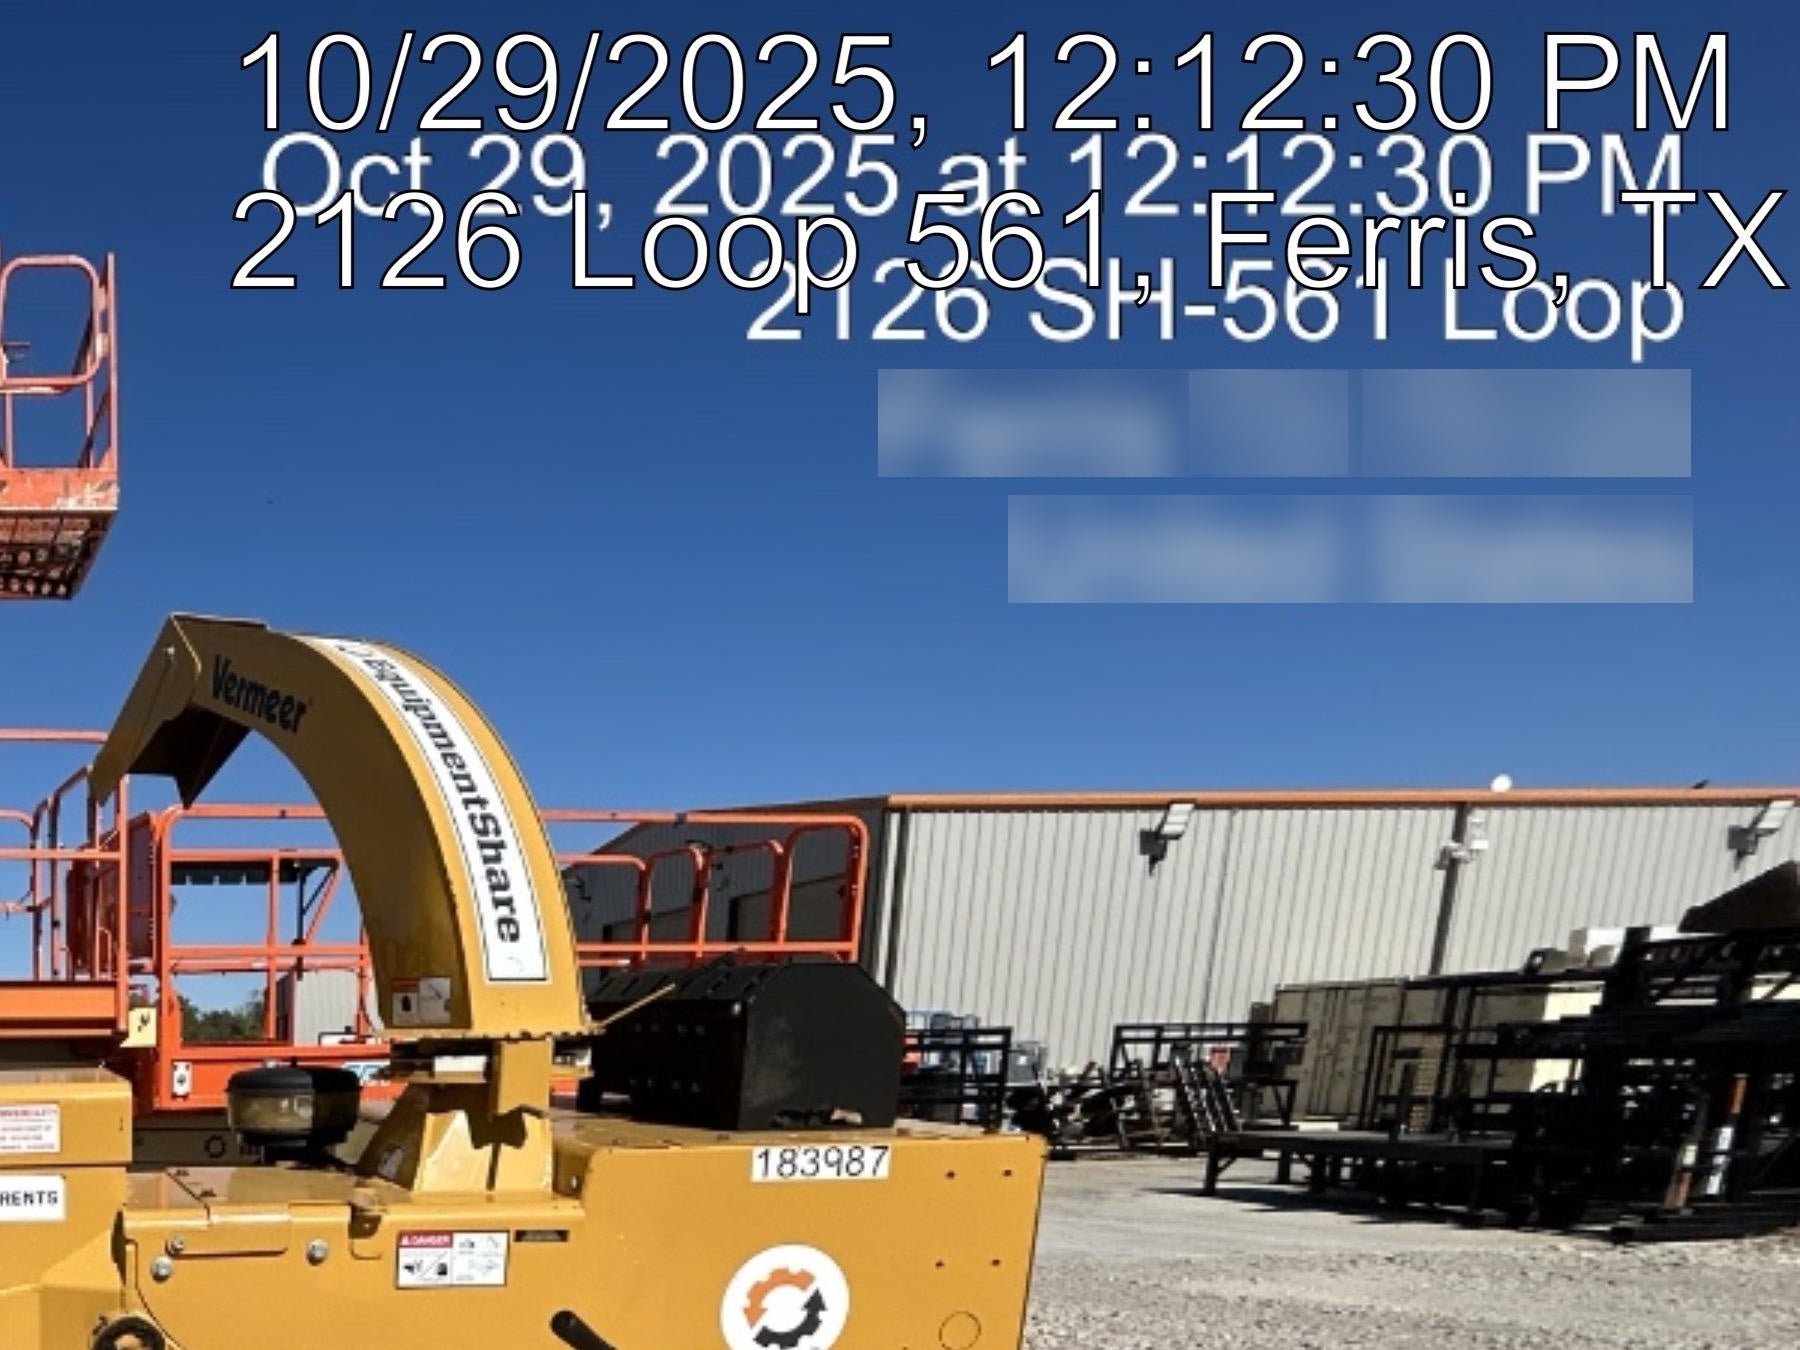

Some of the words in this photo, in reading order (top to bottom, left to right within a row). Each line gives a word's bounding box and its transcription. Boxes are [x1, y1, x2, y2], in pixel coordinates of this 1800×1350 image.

[212, 653, 308, 733] Vermeer
[364, 655, 521, 943] EquipmentShare
[757, 1145, 889, 1178] 183987
